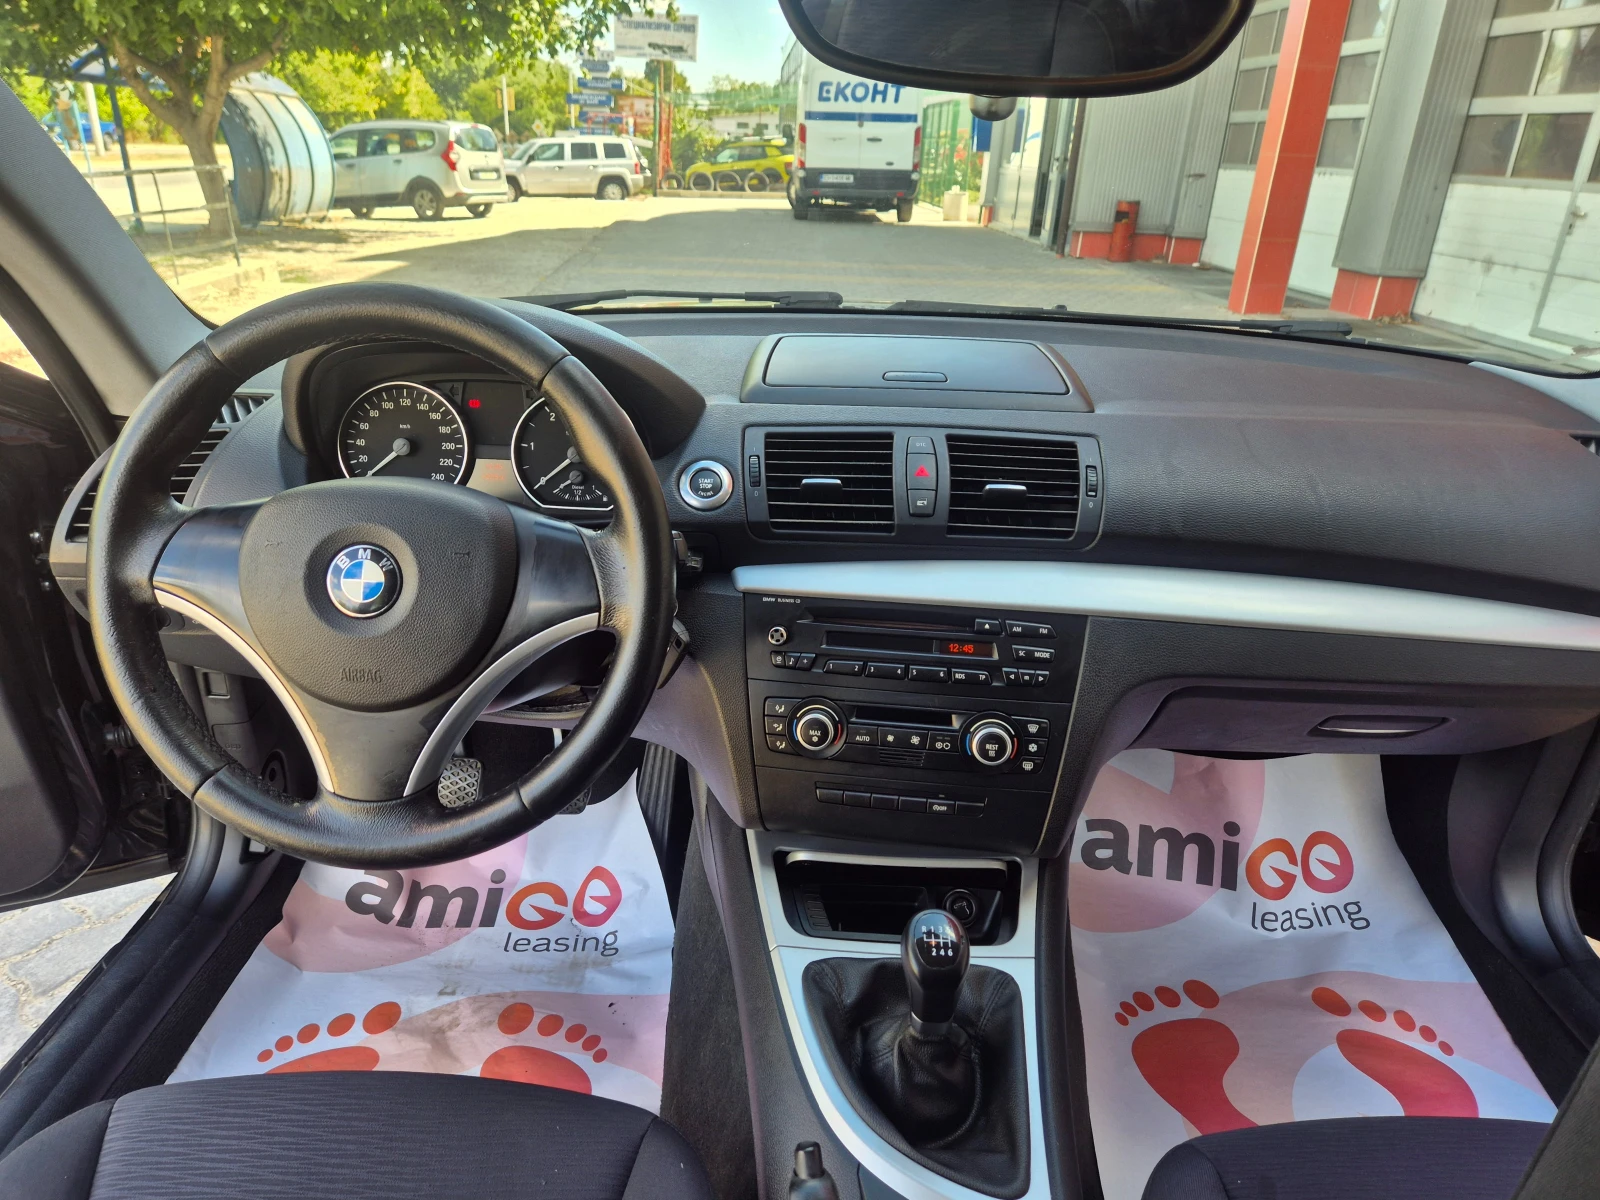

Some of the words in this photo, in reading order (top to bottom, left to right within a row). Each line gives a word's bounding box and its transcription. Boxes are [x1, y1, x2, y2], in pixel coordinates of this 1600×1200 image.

[550, 413, 556, 422] 2
[530, 442, 534, 450] 1
[336, 548, 393, 572] BMW
[948, 644, 974, 654] 12:45
[340, 668, 382, 683] AIRBAG
[1251, 900, 1371, 932] leasing
[503, 930, 620, 957] leasing
[932, 948, 936, 956] 2
[948, 948, 953, 956] 6
